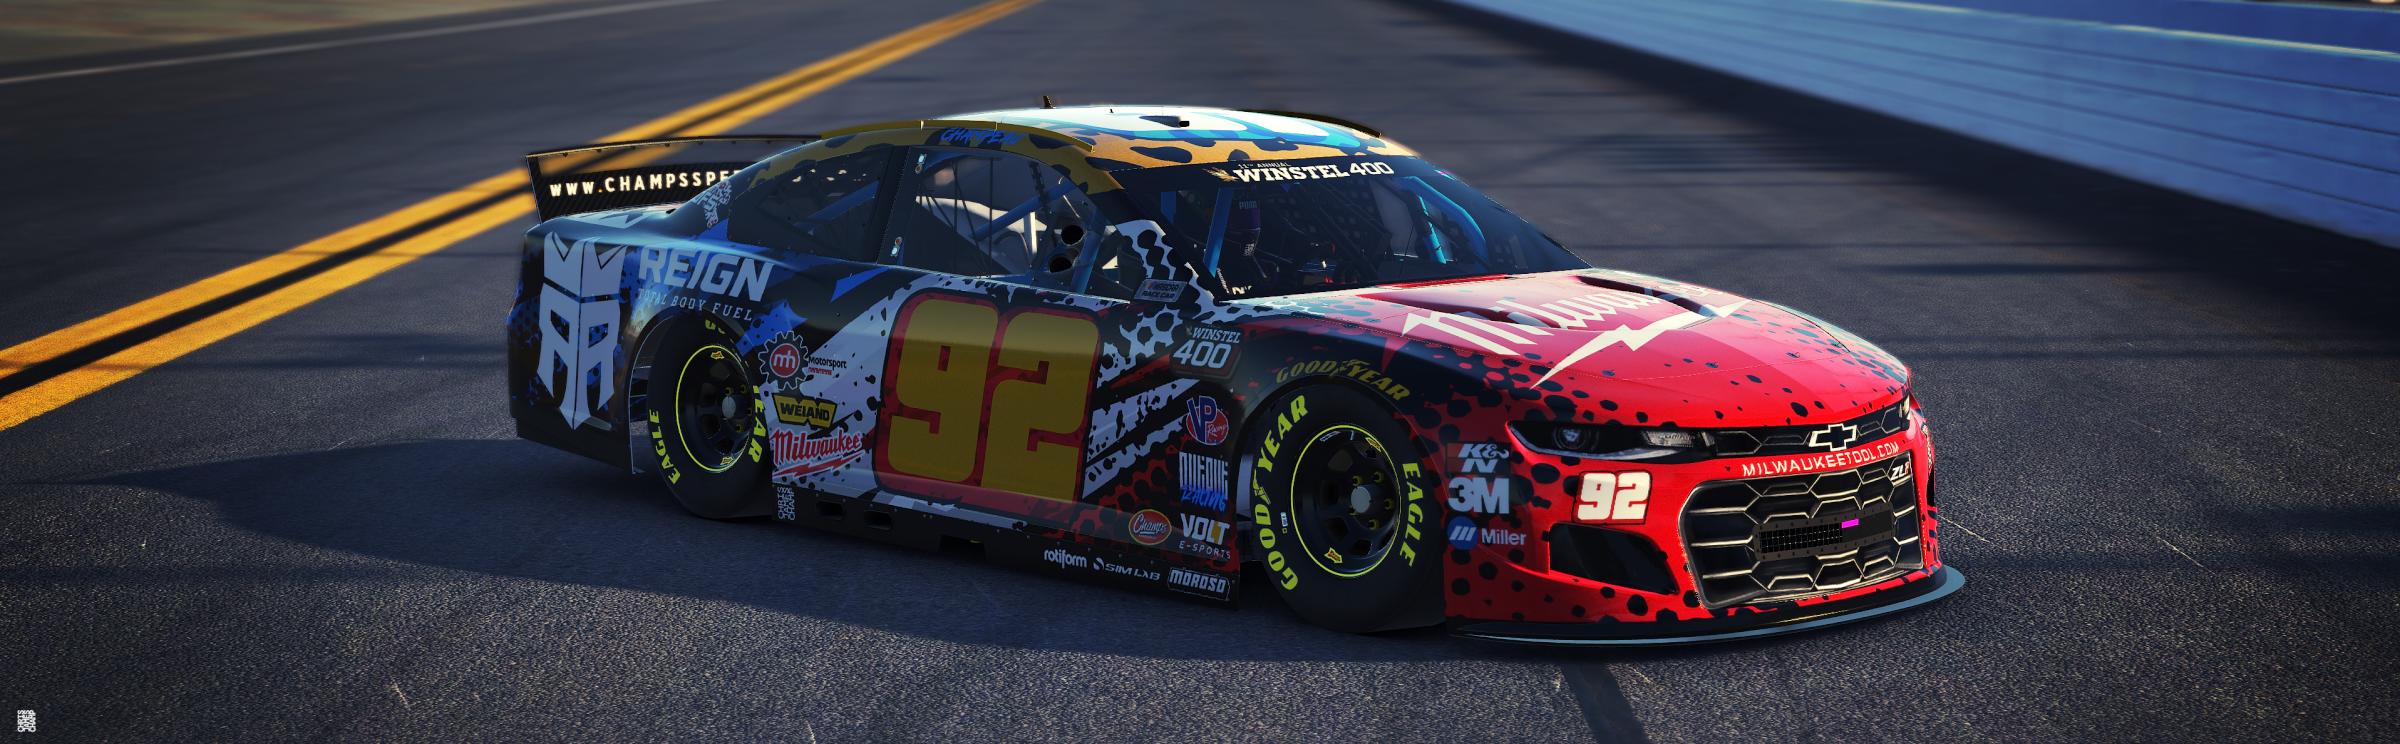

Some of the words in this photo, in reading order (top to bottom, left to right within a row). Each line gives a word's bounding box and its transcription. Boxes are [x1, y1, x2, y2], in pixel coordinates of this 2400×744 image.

[1233, 165, 1350, 183] WINSTEL
[1350, 162, 1394, 176] 400
[638, 246, 775, 302] REIGN
[670, 296, 706, 311] BODY
[711, 302, 753, 321] FUEL
[1193, 327, 1241, 344] WINSTEL
[808, 355, 847, 370] Motorsport
[1173, 339, 1232, 369] 400
[1276, 358, 1411, 401] GOODYEAR
[780, 401, 830, 421] WEIAND
[886, 298, 1099, 504] 92
[649, 408, 681, 485] EAGLE
[769, 427, 863, 466] Milwaukee
[1742, 441, 1900, 477] MILWAUKEETOOL.COM
[1253, 394, 1309, 591] GOODYEAR
[1448, 476, 1510, 515] 3M
[1577, 471, 1648, 523] 92
[1180, 512, 1231, 546] VOLT
[1400, 462, 1424, 567] EAGLE
[1178, 540, 1232, 560] E-SPORTS
[1481, 527, 1527, 546] Miller
[1043, 549, 1088, 569] rotiform
[1169, 569, 1227, 593] MOROSO
